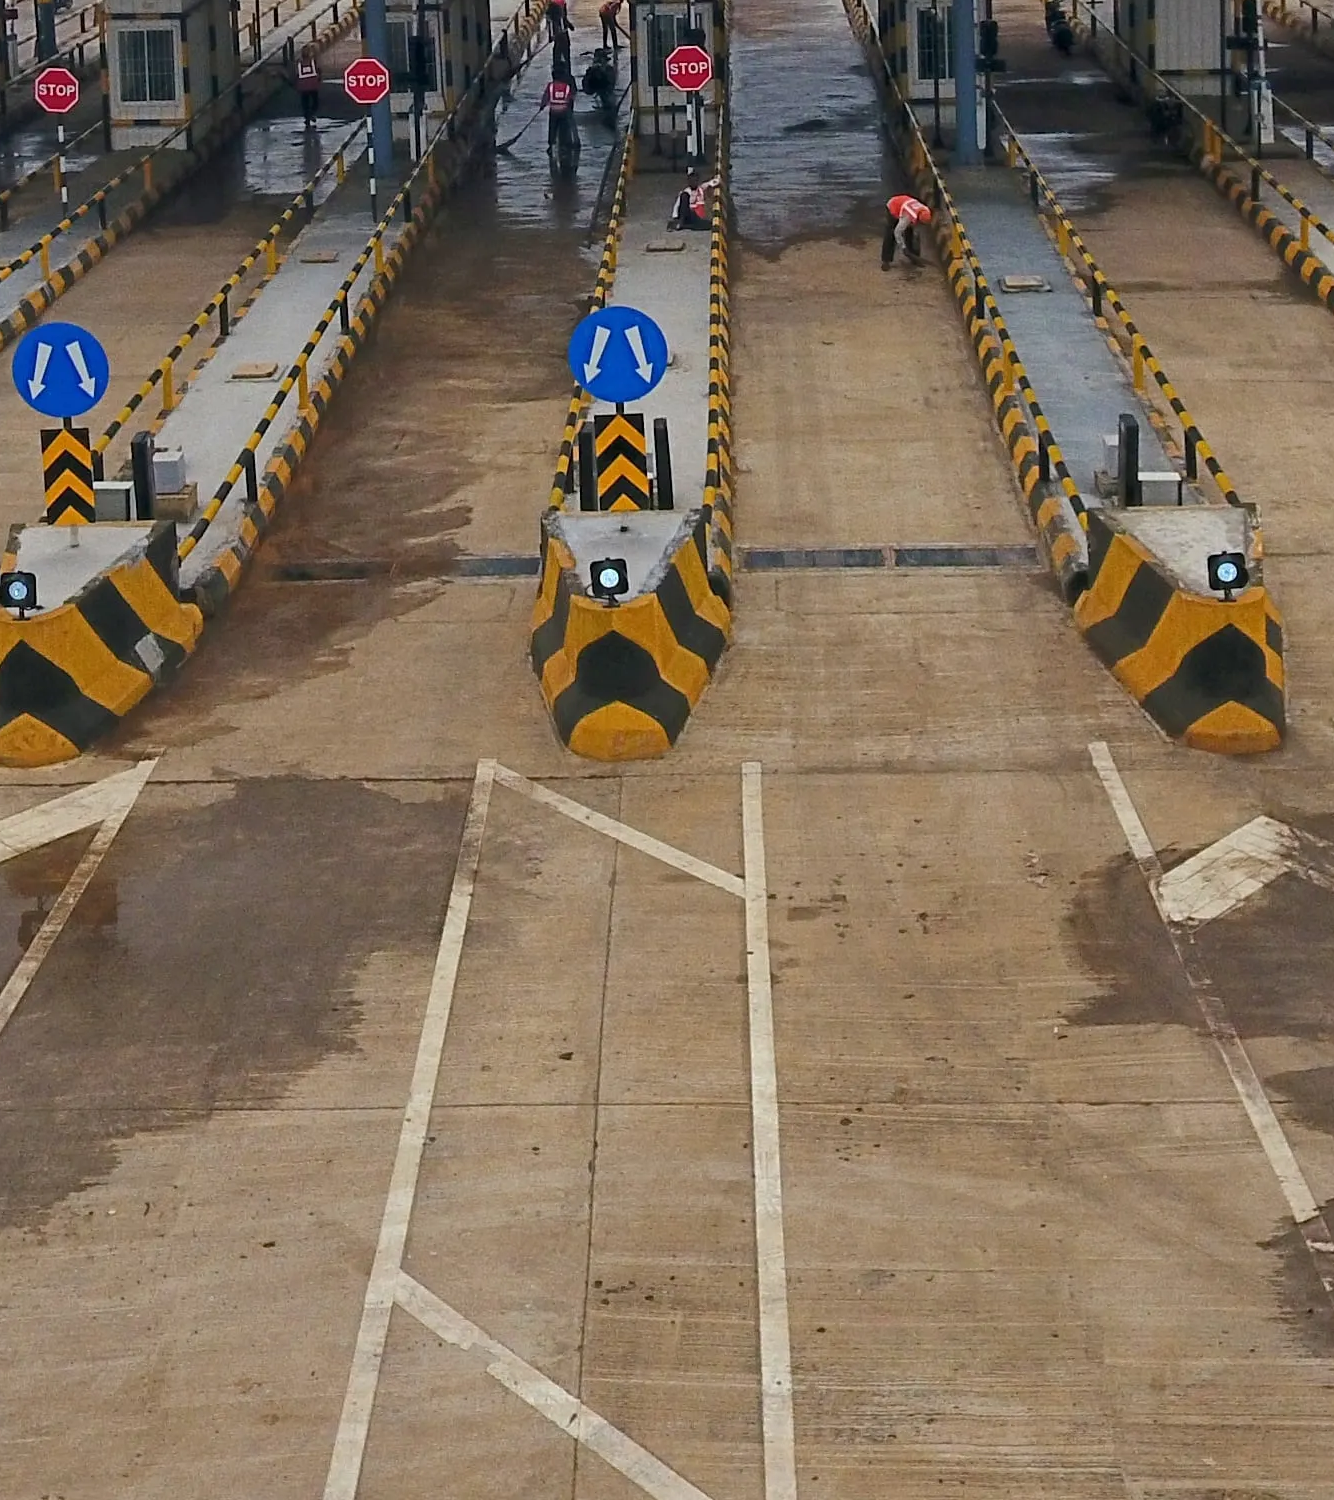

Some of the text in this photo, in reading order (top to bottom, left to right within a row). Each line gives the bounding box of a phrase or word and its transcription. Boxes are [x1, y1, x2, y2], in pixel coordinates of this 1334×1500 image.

[670, 62, 708, 75] STOP
[348, 75, 386, 87] STOP
[38, 83, 76, 97] STOP
